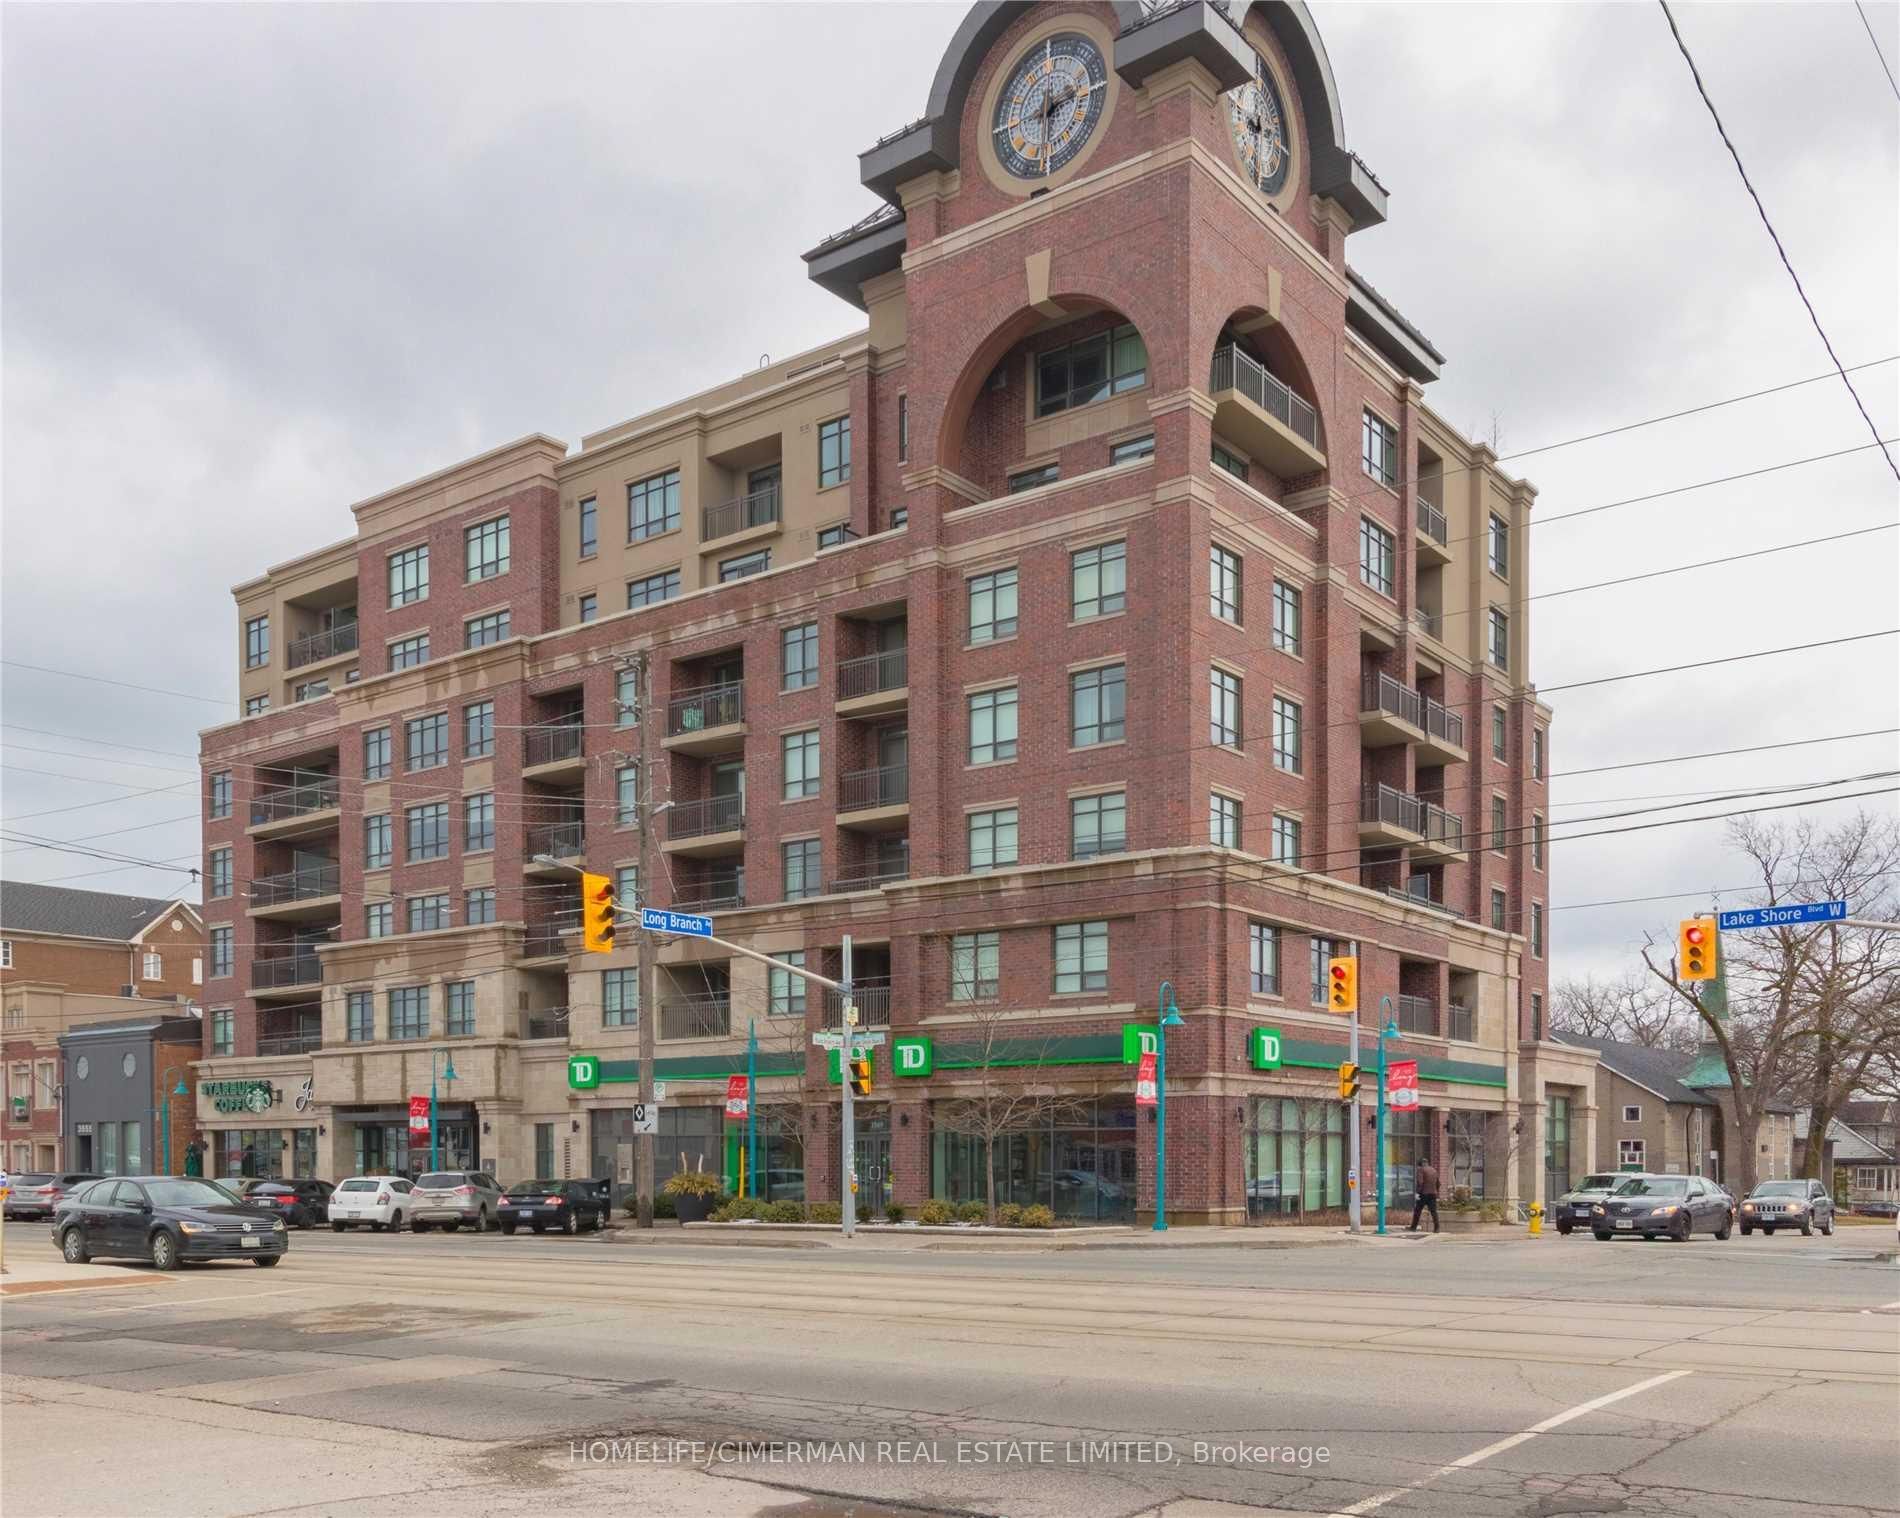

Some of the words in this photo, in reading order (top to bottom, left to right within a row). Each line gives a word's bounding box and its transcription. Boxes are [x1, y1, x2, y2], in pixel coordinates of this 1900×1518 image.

[644, 911, 667, 929] Long
[670, 915, 702, 931] Branch
[1722, 913, 1755, 926] Lake
[1760, 909, 1802, 923] Shore
[1807, 904, 1824, 913] Blvd
[1828, 904, 1842, 917] W
[1137, 1032, 1157, 1054] TD
[1260, 1035, 1279, 1062] TD
[897, 1045, 925, 1068] TD
[572, 1062, 592, 1082] TD
